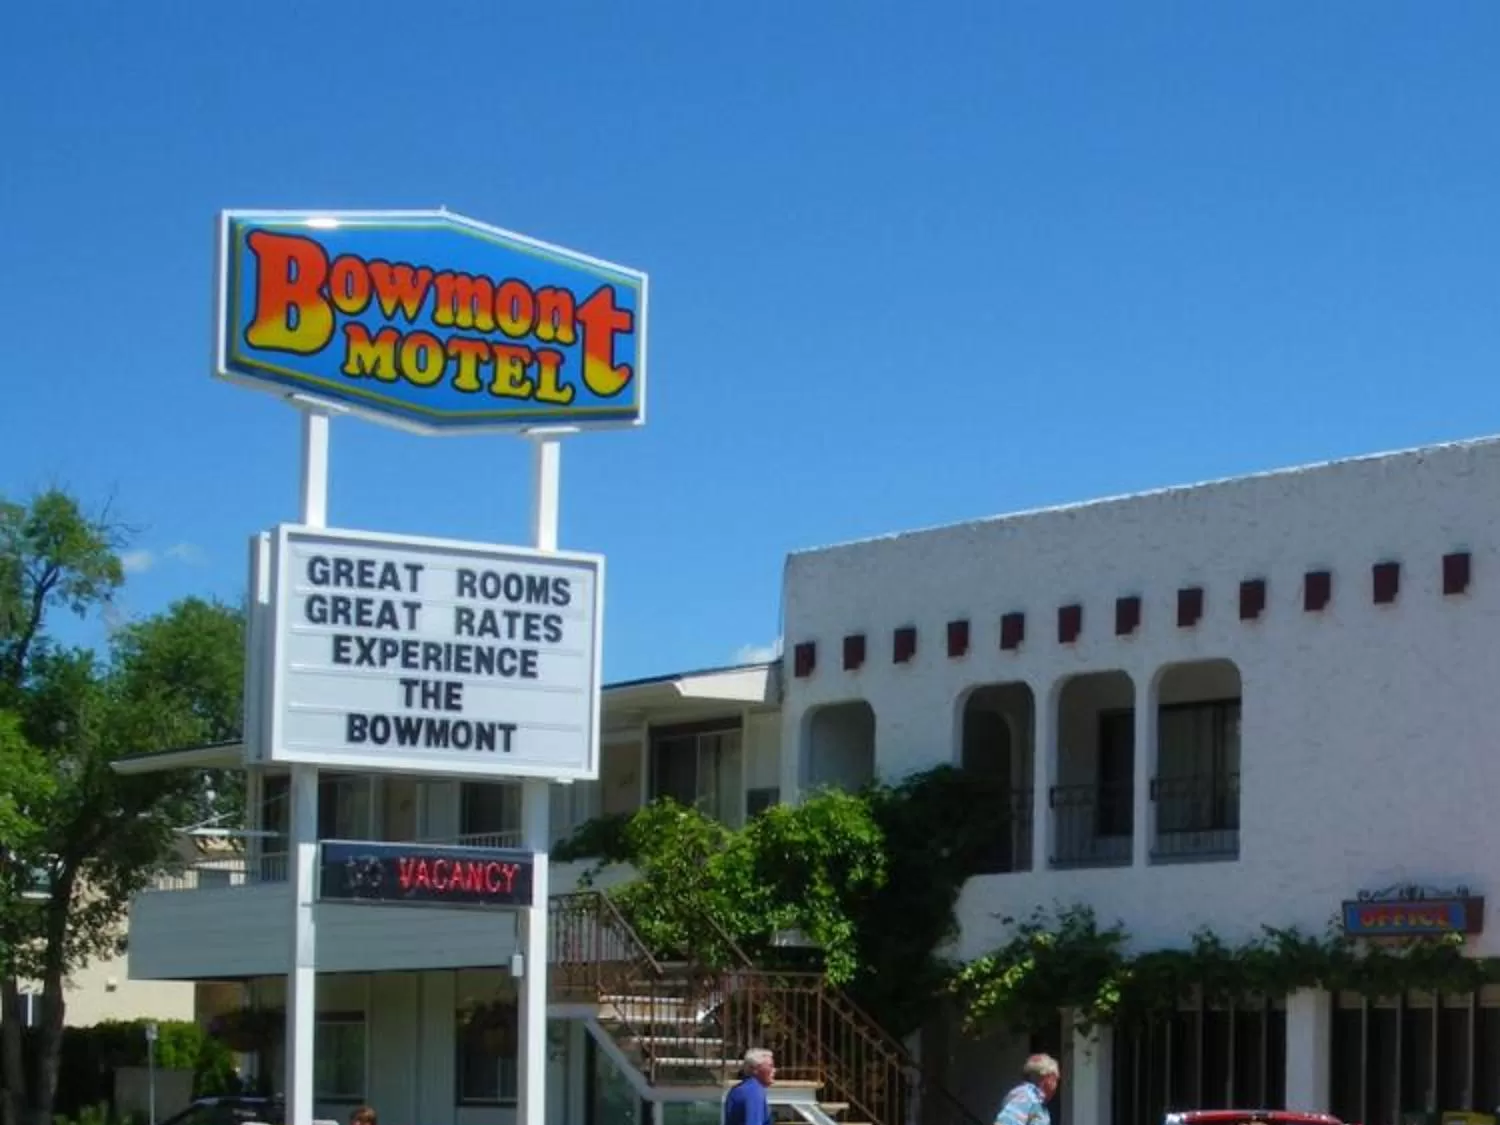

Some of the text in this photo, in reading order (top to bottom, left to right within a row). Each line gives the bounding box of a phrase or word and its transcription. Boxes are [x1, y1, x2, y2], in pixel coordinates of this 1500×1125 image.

[245, 228, 634, 397] Bowmont
[342, 323, 576, 405] MOTEL
[307, 555, 572, 607] GREAT ROOMS
[305, 594, 564, 643] GREAT RATES
[332, 634, 540, 679] EXPERIENCE
[399, 678, 464, 712] THE
[346, 712, 518, 753] BOWMONT
[398, 857, 520, 893] VACANCY
